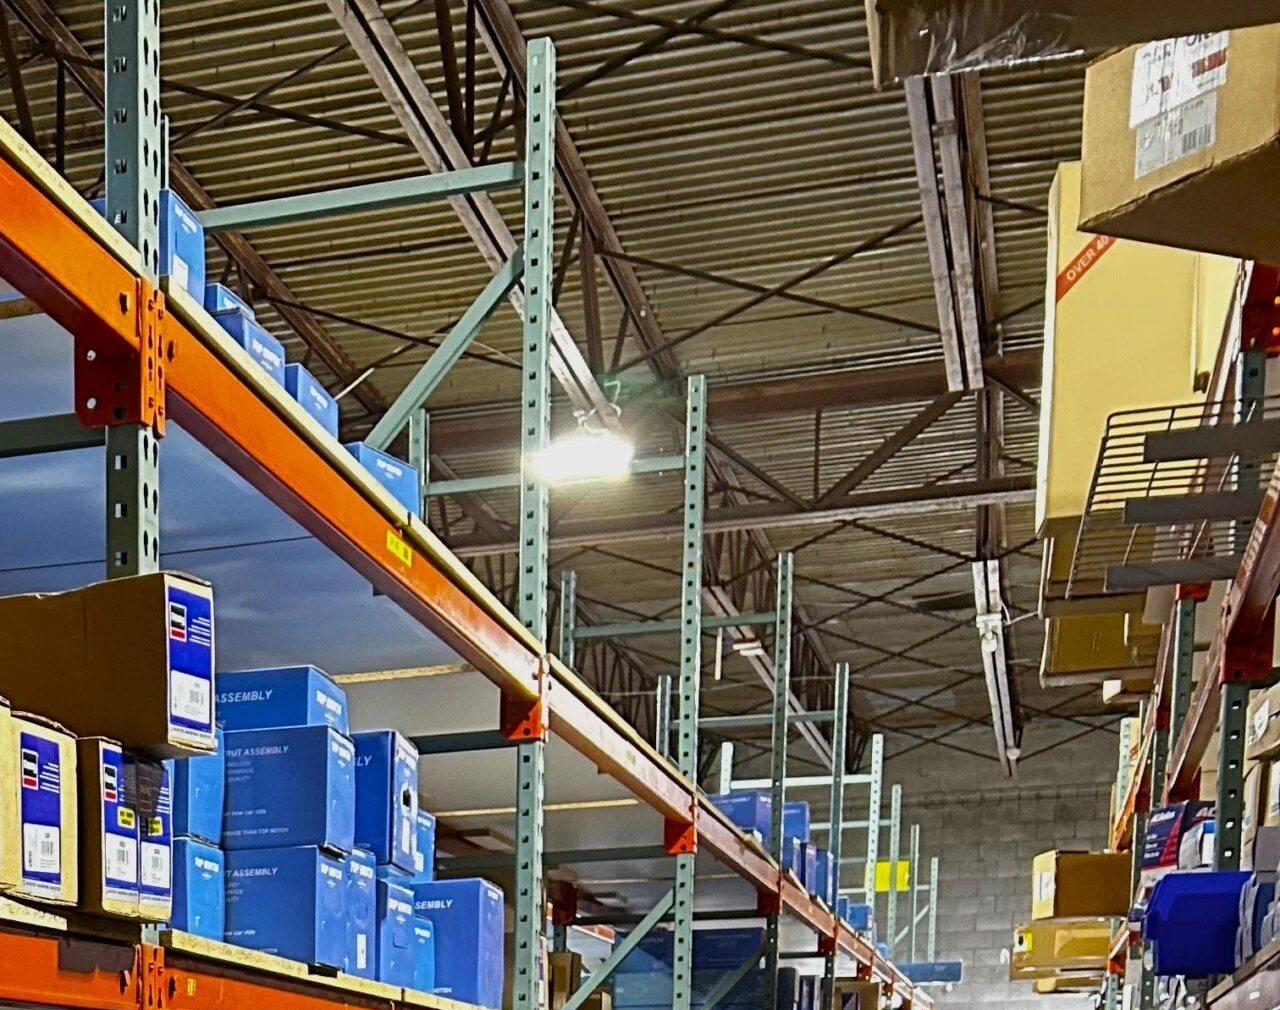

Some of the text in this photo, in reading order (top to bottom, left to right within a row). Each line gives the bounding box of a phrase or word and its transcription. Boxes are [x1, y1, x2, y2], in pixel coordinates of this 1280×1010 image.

[1067, 248, 1095, 281] OVER
[243, 745, 289, 756] ASSEMBLY
[233, 867, 278, 877] ASSEMBLY
[415, 900, 453, 910] SEMBLY
